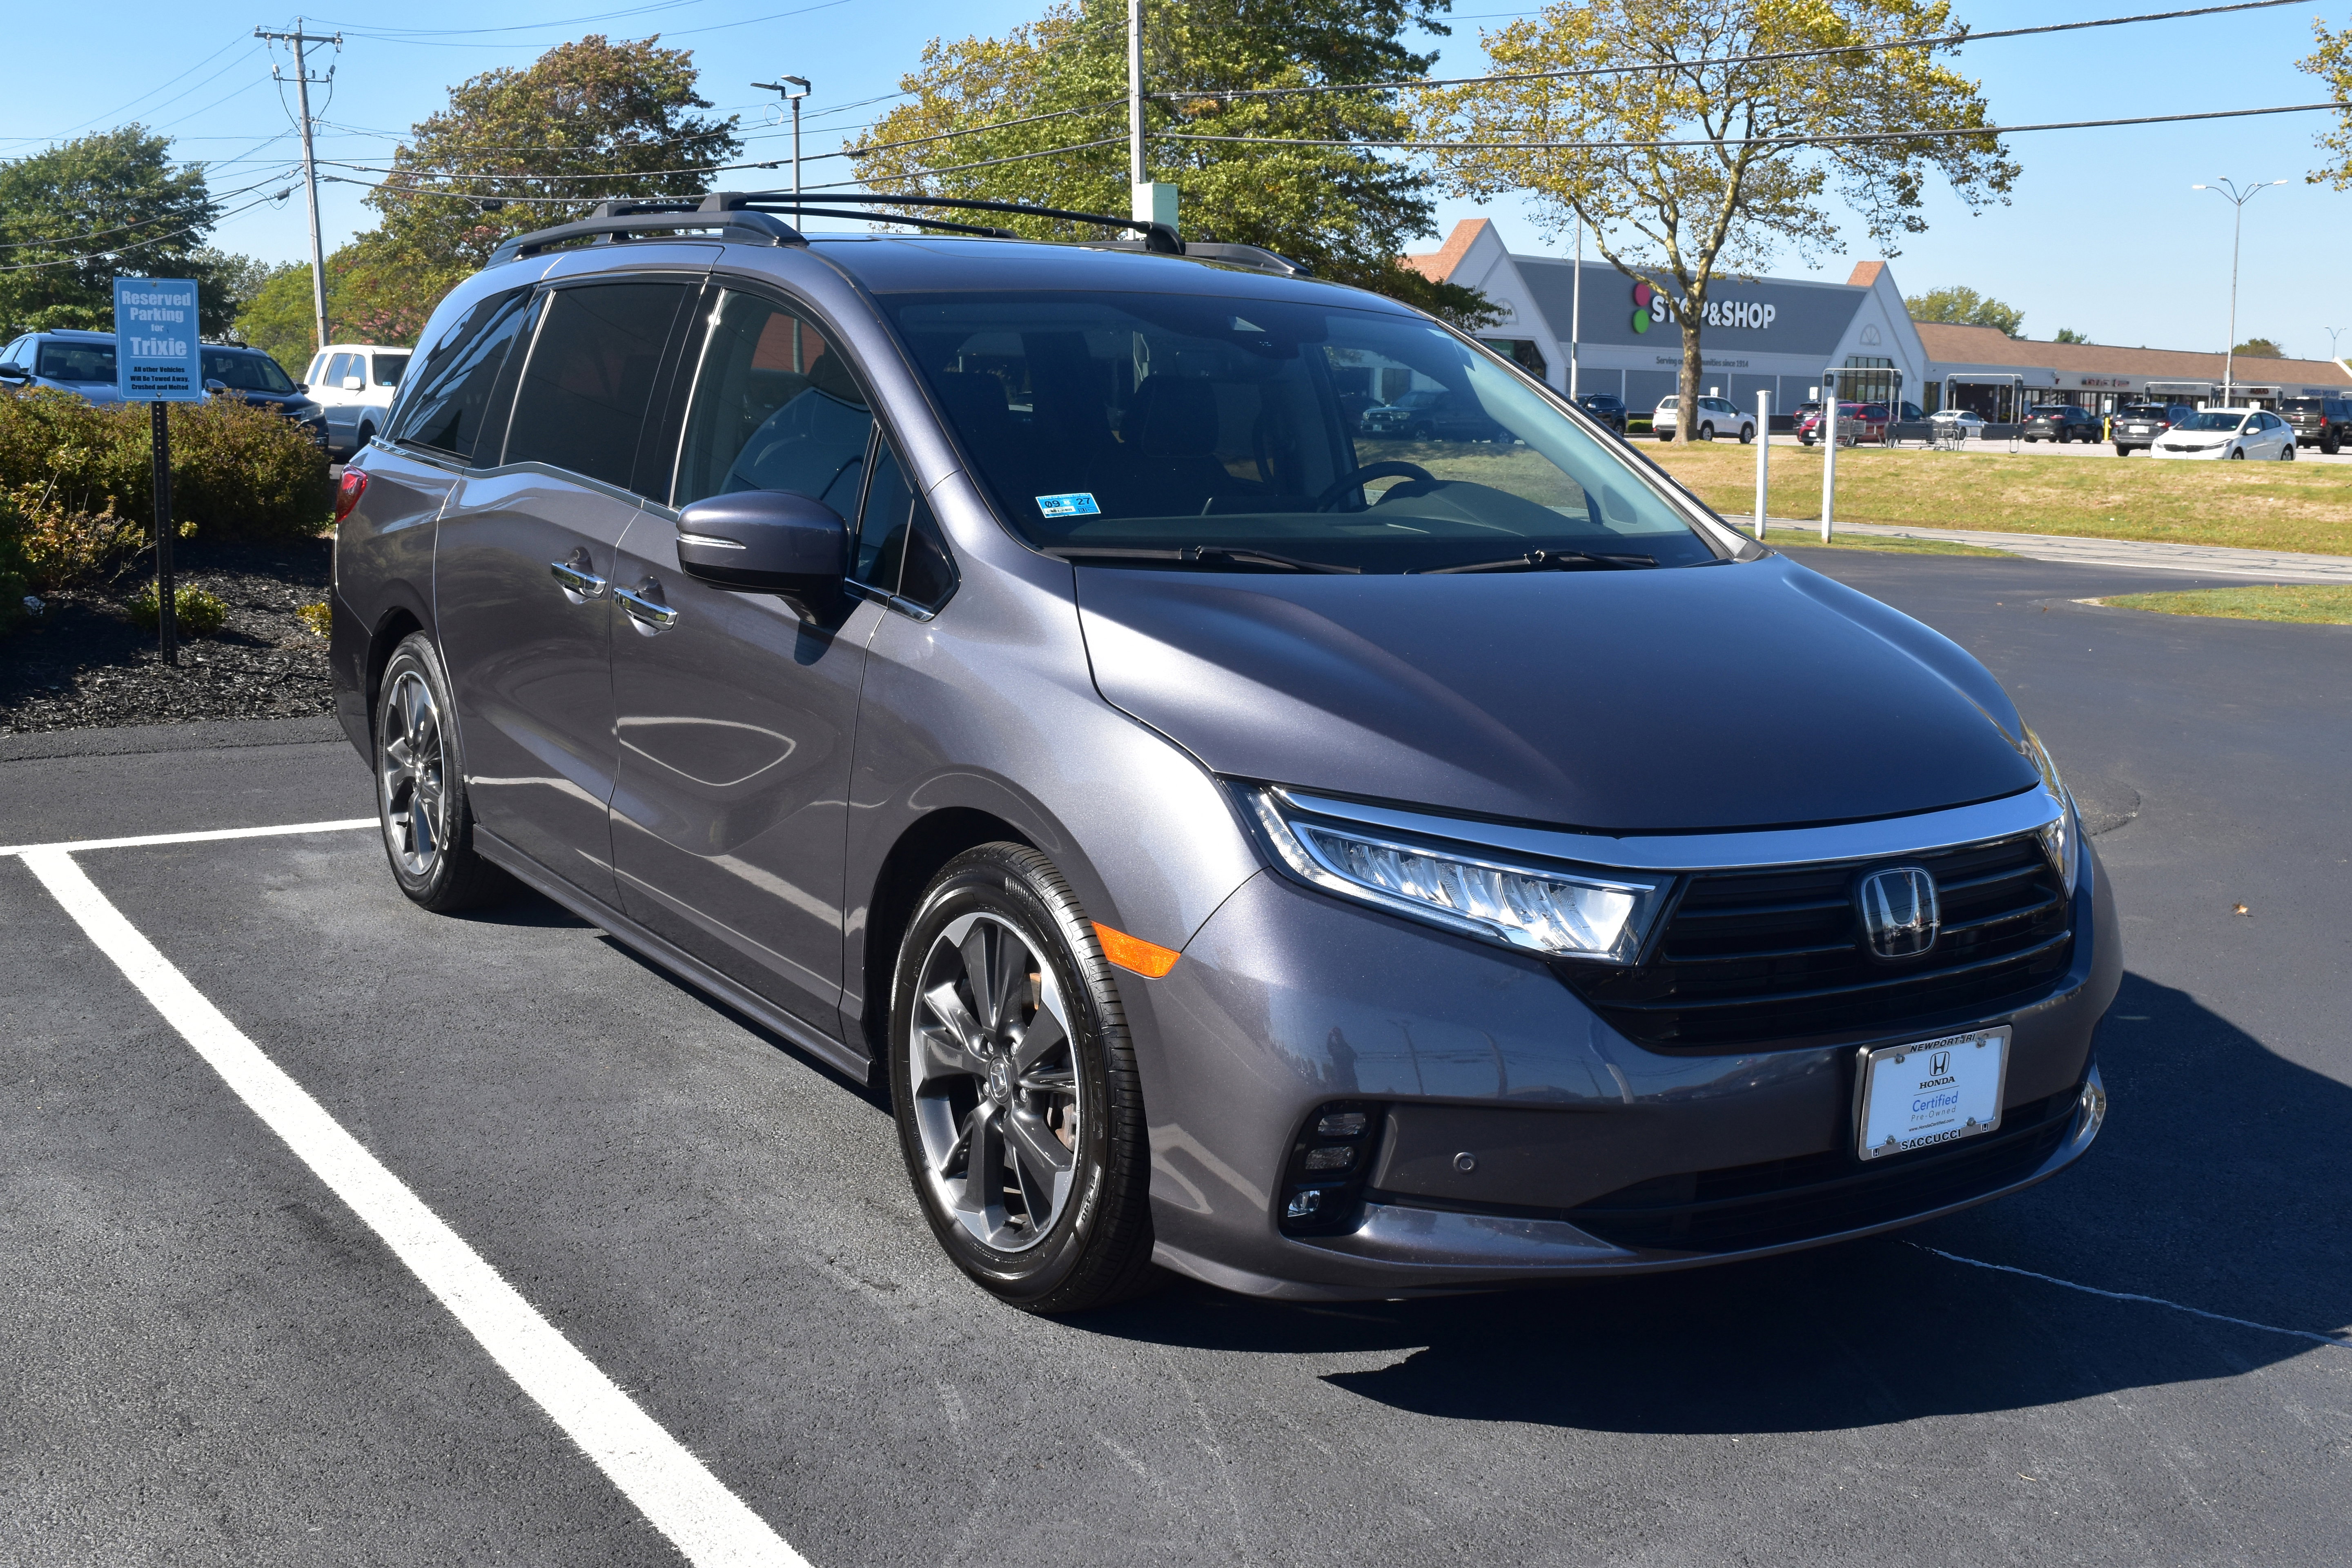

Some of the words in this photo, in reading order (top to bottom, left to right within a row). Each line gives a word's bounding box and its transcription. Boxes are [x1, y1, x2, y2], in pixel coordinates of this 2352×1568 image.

[122, 291, 191, 306] Reserved
[130, 307, 183, 323] Parking
[130, 337, 187, 356] Trixie
[1656, 356, 1677, 366] Serving
[1722, 359, 1735, 367] since
[1965, 1033, 1976, 1042] RI
[1919, 1076, 1956, 1089] HONDA
[1912, 1091, 1958, 1112] Certified
[1911, 1106, 1956, 1122] Pre-Owned
[1909, 1118, 1955, 1132] www.HondaCertified.com
[1900, 1129, 1961, 1151] SACCUCCI
